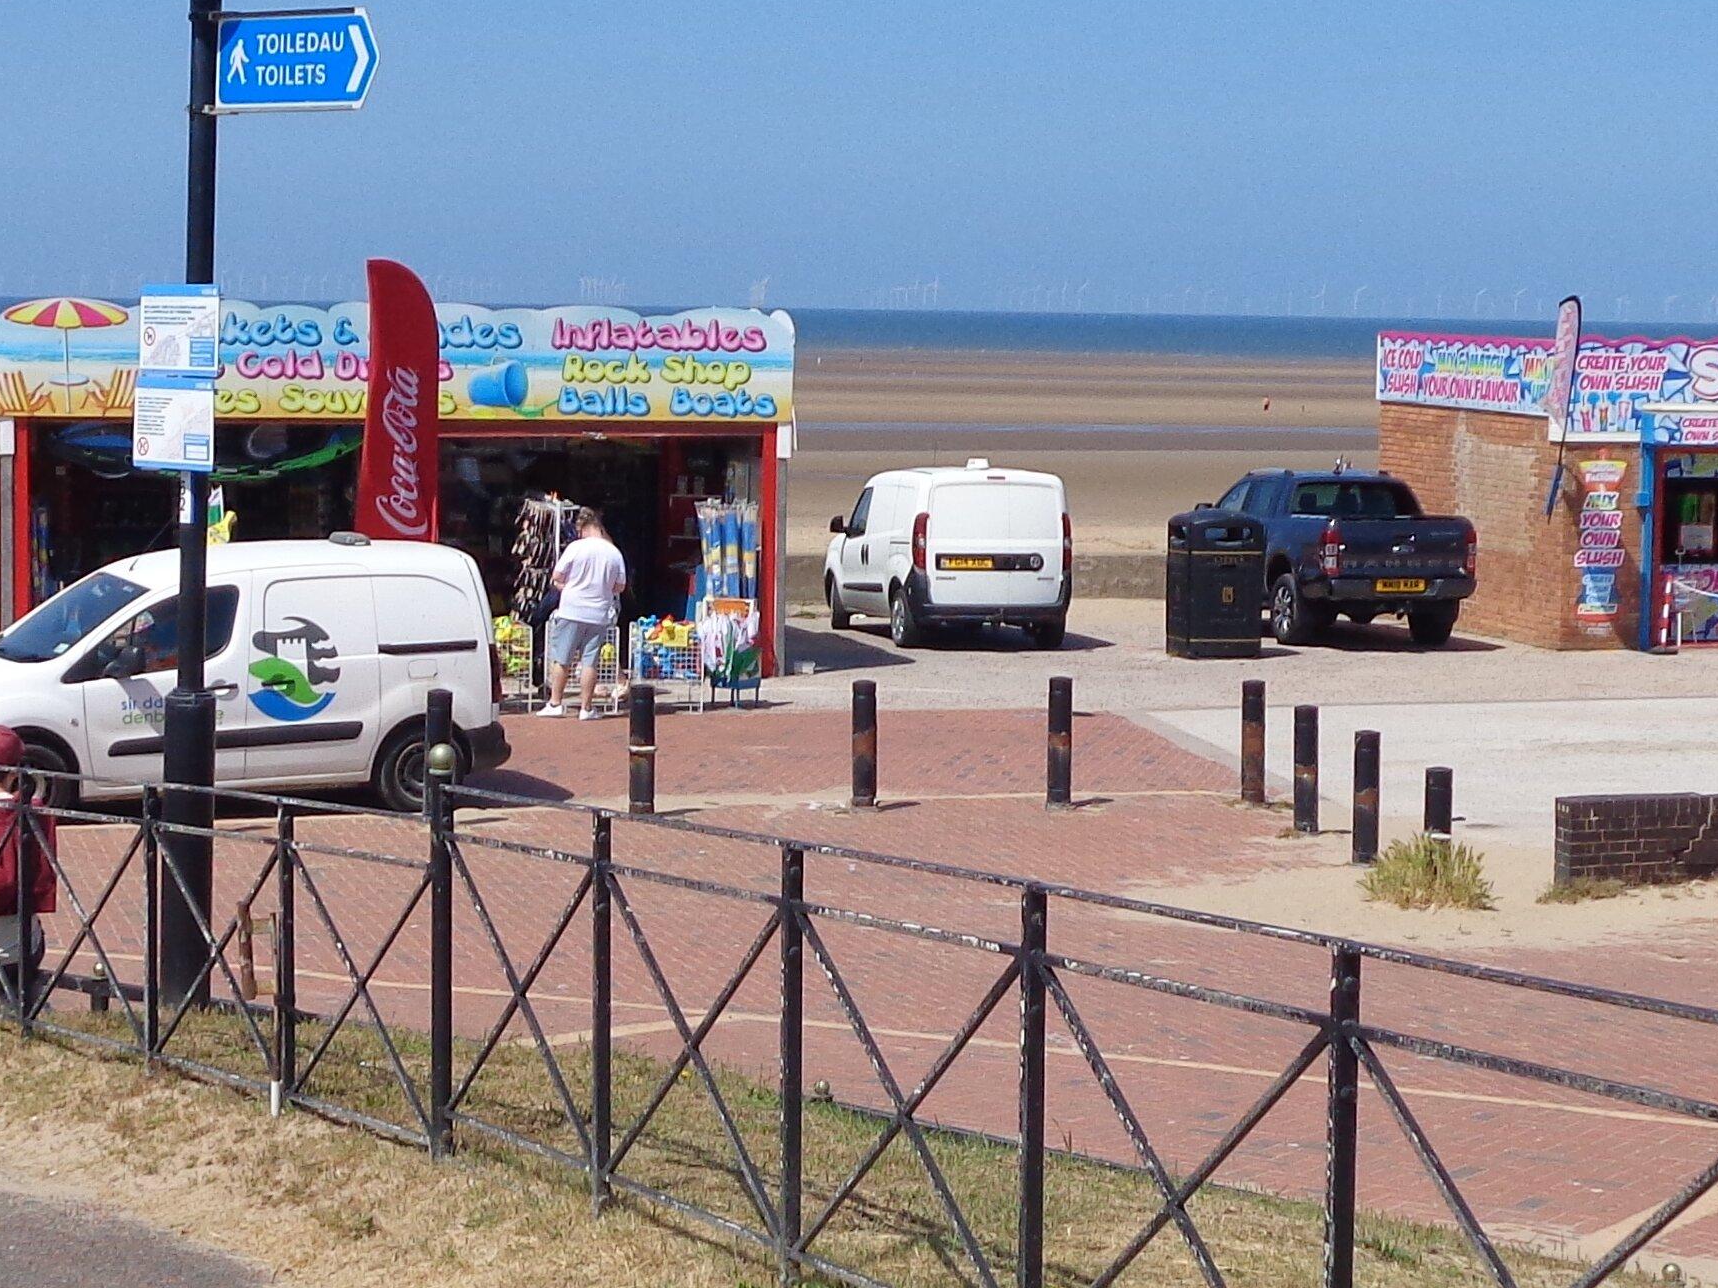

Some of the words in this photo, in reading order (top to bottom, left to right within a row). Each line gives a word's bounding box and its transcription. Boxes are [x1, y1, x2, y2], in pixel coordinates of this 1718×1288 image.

[256, 31, 345, 55] TOILEDAU
[255, 64, 326, 87] TOILETS
[332, 316, 360, 345] &
[551, 317, 767, 352] Inflatables
[237, 349, 325, 380] Cold
[1383, 348, 1397, 369] ICE
[1398, 349, 1424, 371] COLD
[1577, 355, 1627, 371] CREATE
[1630, 355, 1667, 371] YOUR
[561, 352, 652, 384] Rock
[660, 353, 751, 392] Shop
[1387, 371, 1419, 394] SLUSH
[1579, 374, 1613, 390] OWN
[1615, 376, 1661, 391] SLUSH
[1423, 375, 1447, 397] YOUR
[1449, 378, 1473, 400] OWN
[1474, 379, 1519, 404] FLAVOUR
[557, 385, 651, 417] Balls
[669, 387, 778, 418] Boats
[1683, 418, 1718, 427] CREATE
[1684, 431, 1710, 440] OWN
[1582, 515, 1619, 528] YOUR
[1582, 533, 1618, 546] OWN
[1576, 551, 1623, 565] SLUSH
[121, 697, 136, 710] sir
